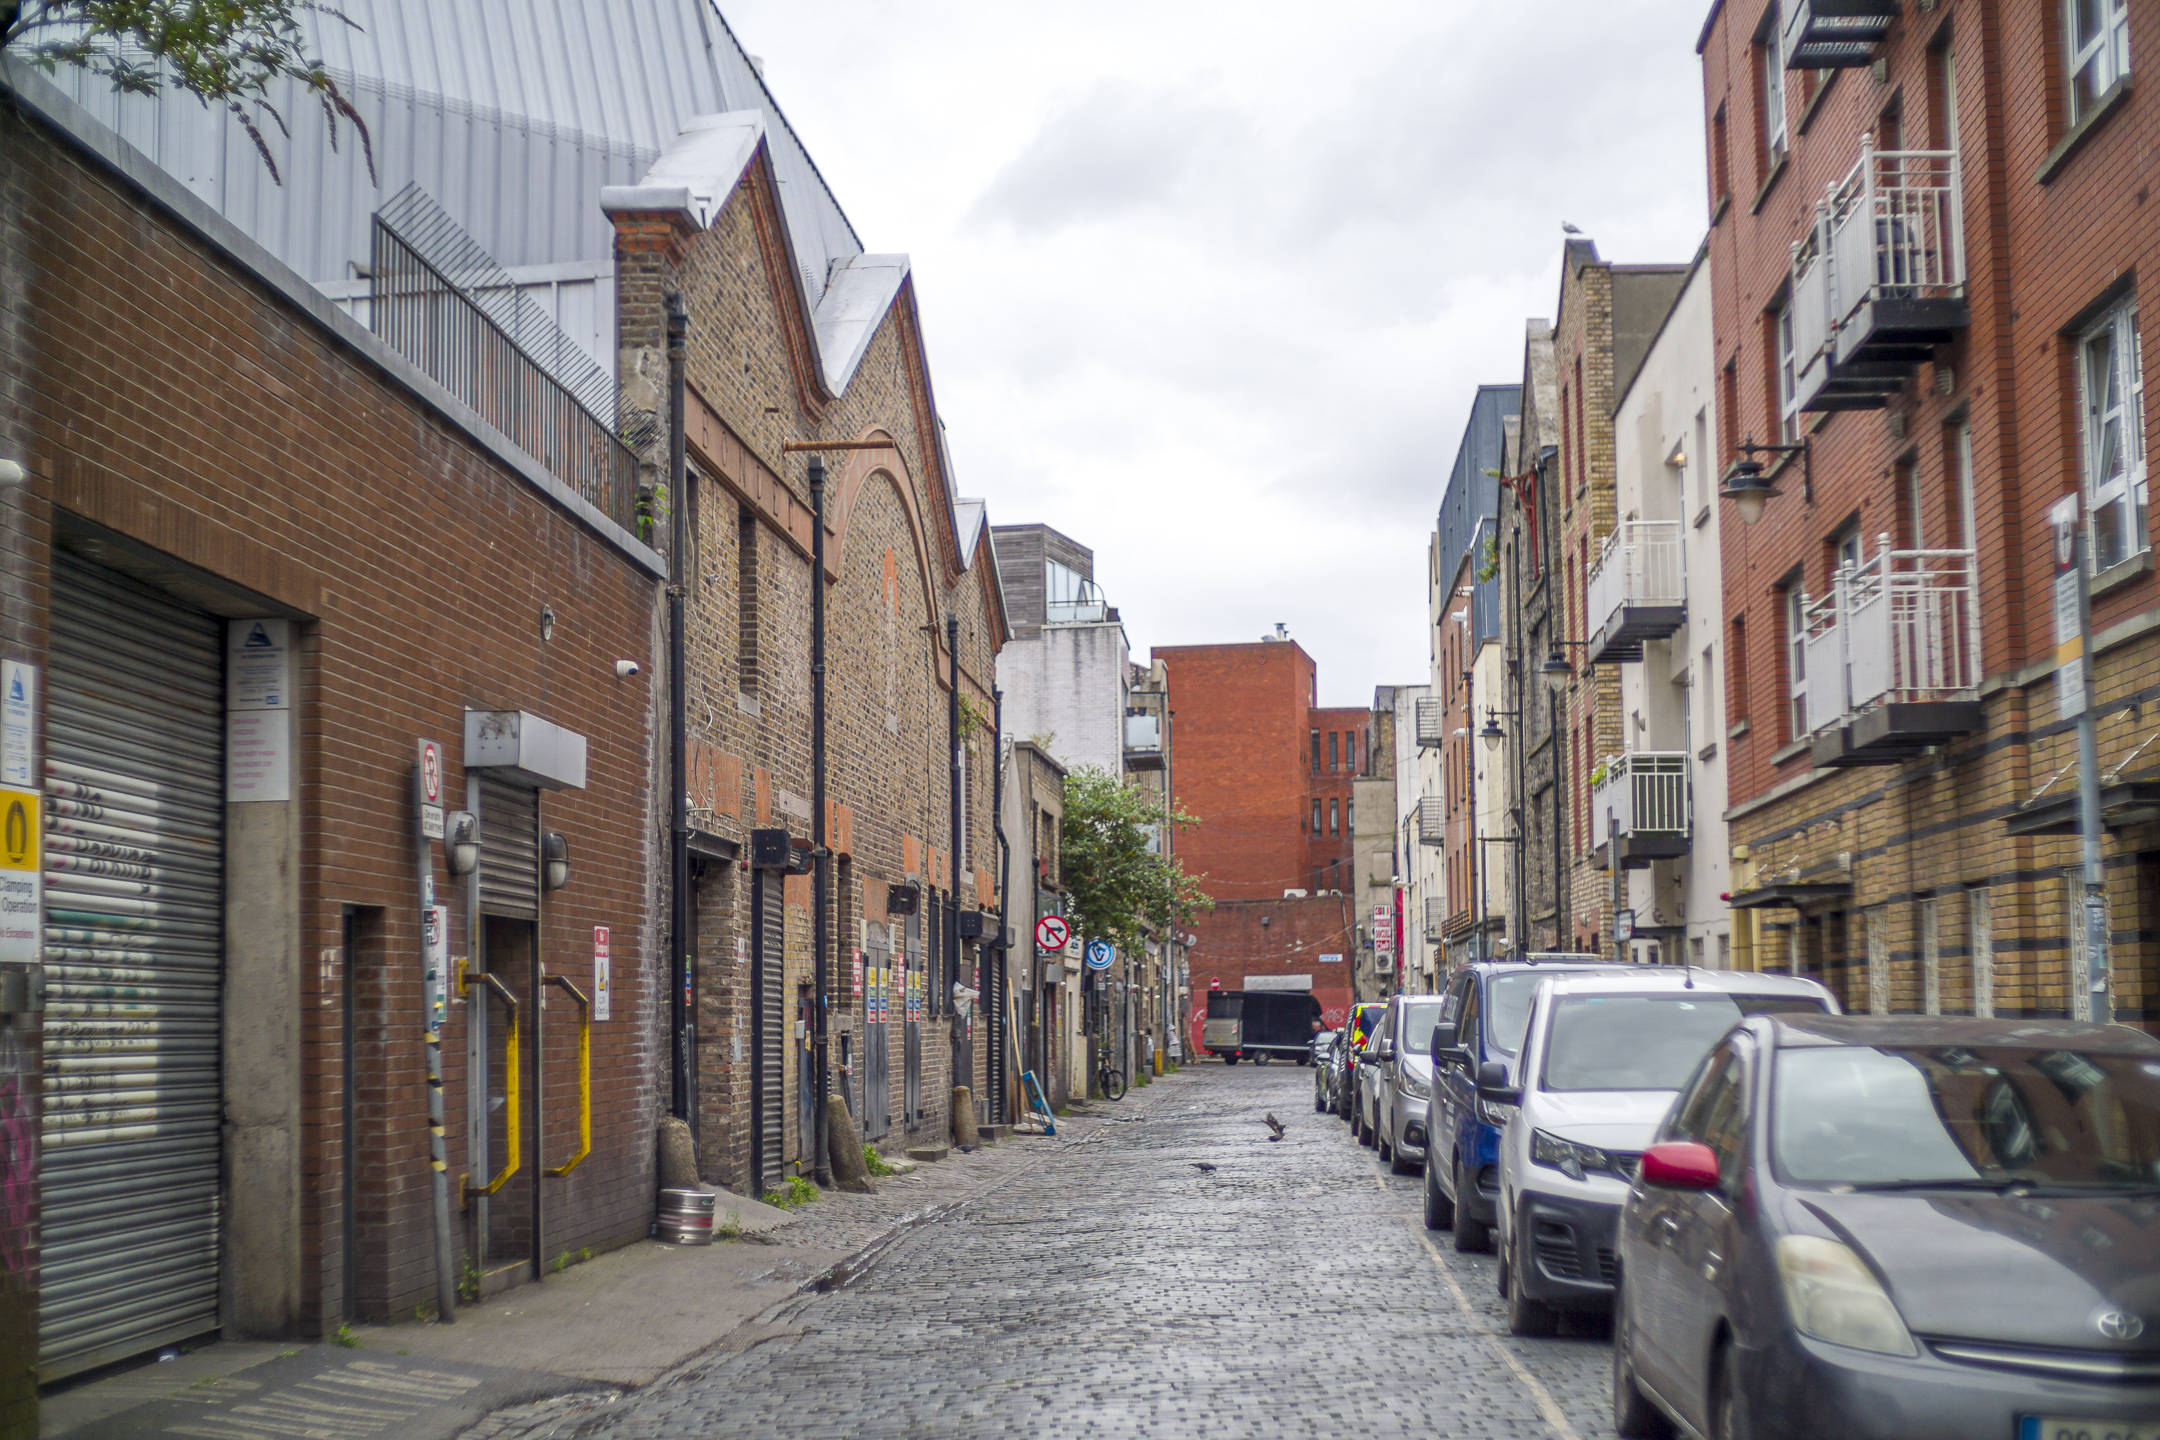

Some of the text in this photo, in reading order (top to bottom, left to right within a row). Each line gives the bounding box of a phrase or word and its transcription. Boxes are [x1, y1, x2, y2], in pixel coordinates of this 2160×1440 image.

[0, 876, 33, 898] Clamping
[3, 896, 37, 916] Operation
[6, 927, 34, 941] Exceptions
[161, 1360, 482, 1440] PARKING
